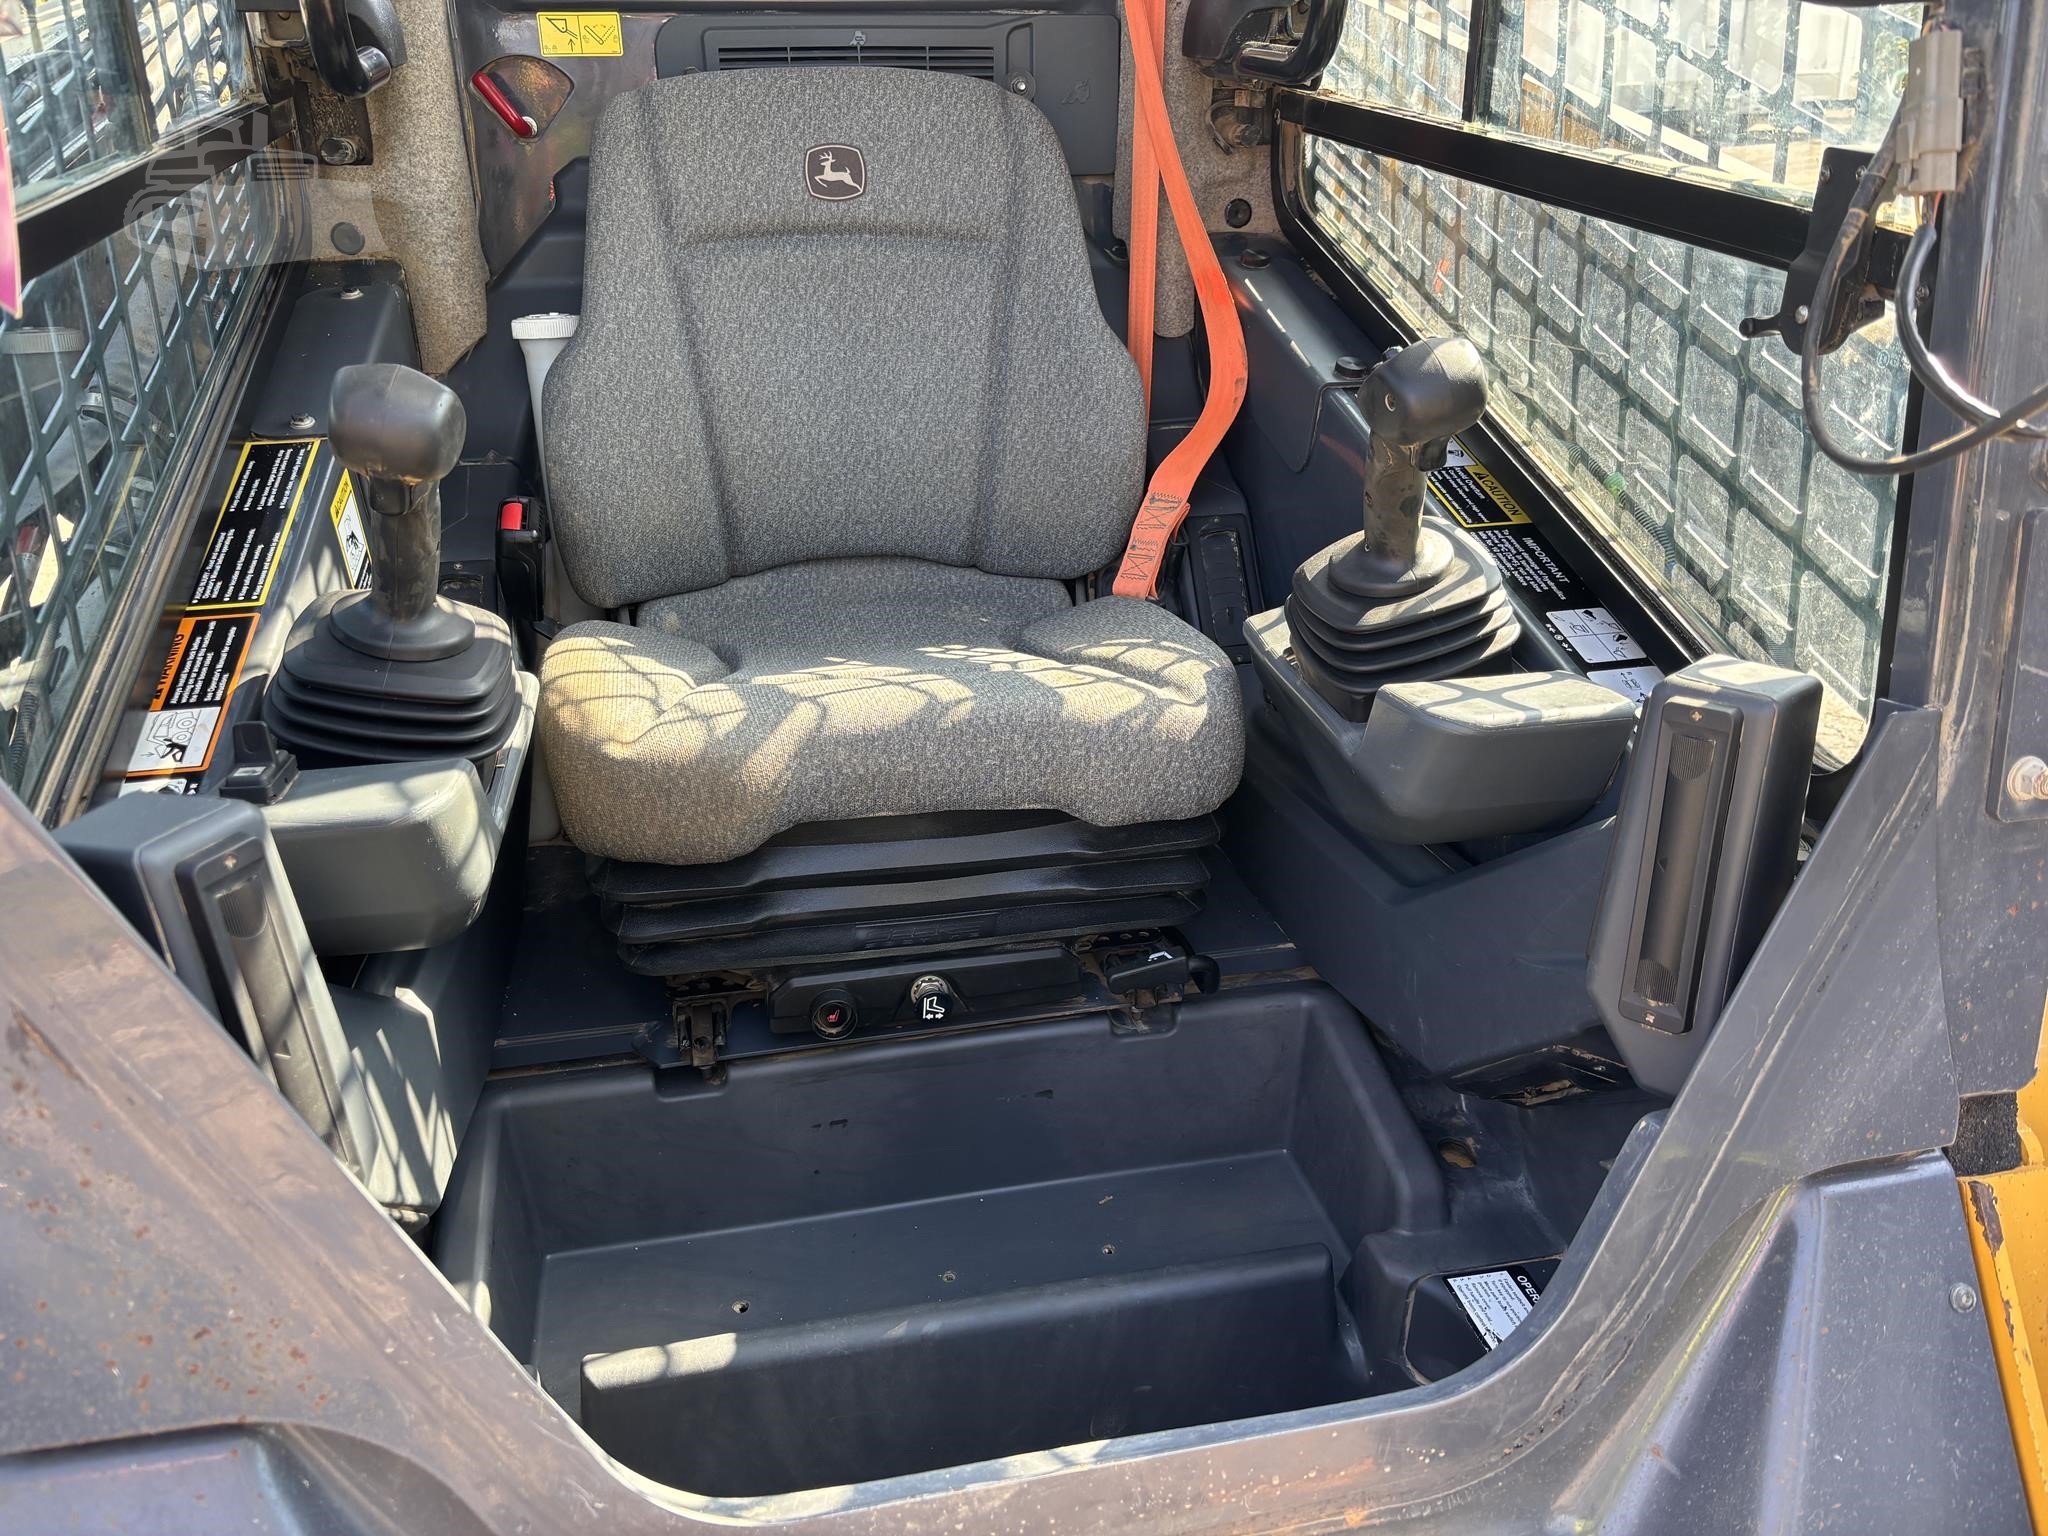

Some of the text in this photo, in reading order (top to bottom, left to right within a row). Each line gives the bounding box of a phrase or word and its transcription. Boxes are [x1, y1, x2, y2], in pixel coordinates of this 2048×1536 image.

[1482, 480, 1523, 515] CAUTION
[1522, 538, 1570, 583] IMPORTANT
[1517, 1276, 1541, 1304] OPER
